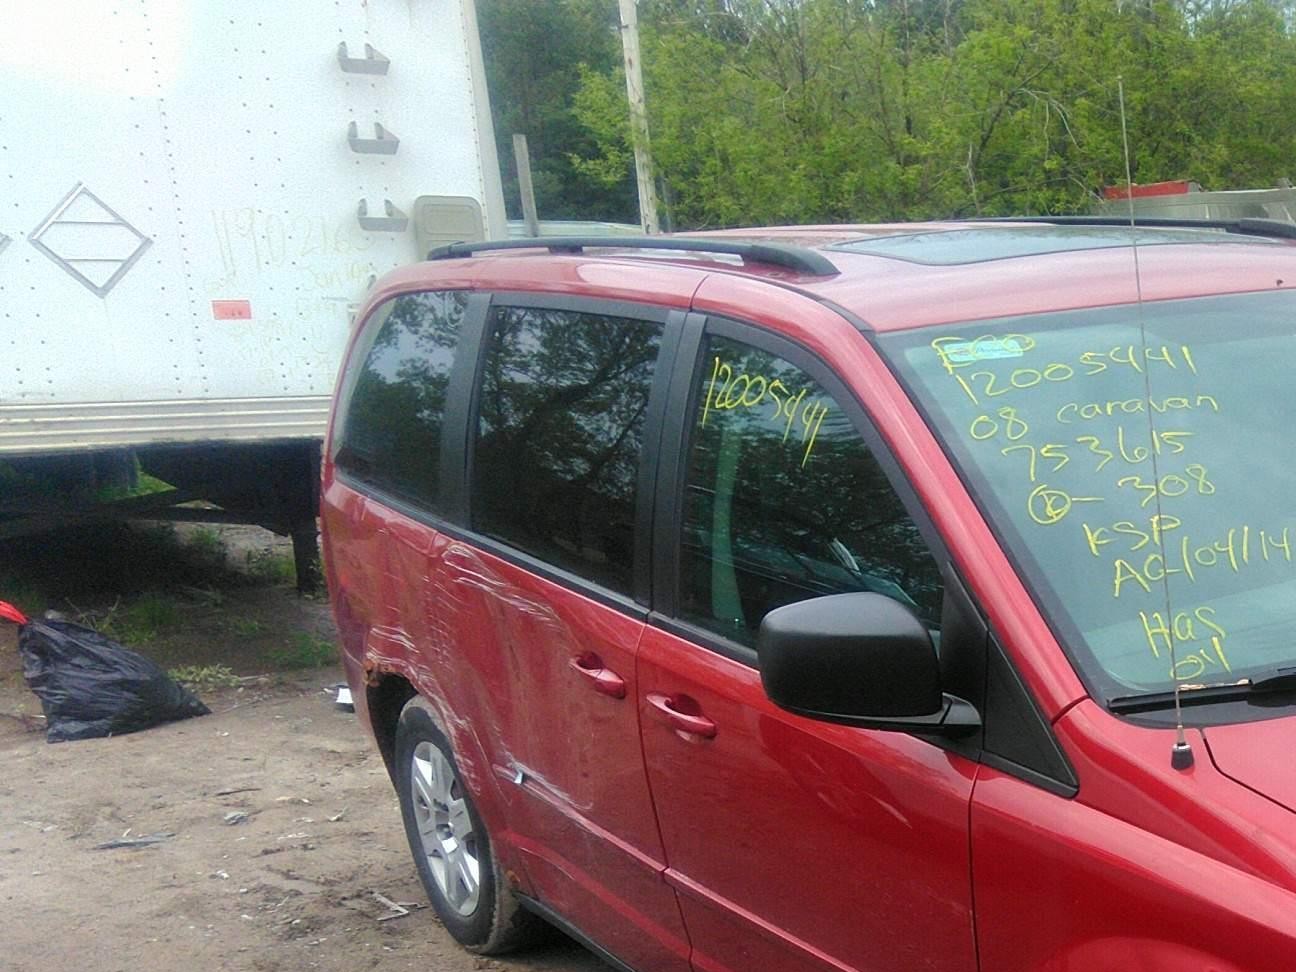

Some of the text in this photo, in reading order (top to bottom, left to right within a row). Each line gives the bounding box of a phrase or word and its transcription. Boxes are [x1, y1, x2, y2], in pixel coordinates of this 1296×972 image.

[954, 345, 1199, 405] 12005441
[701, 355, 828, 470] 12005441
[970, 395, 1220, 441] 08 caravan
[1117, 464, 1217, 508] 308
